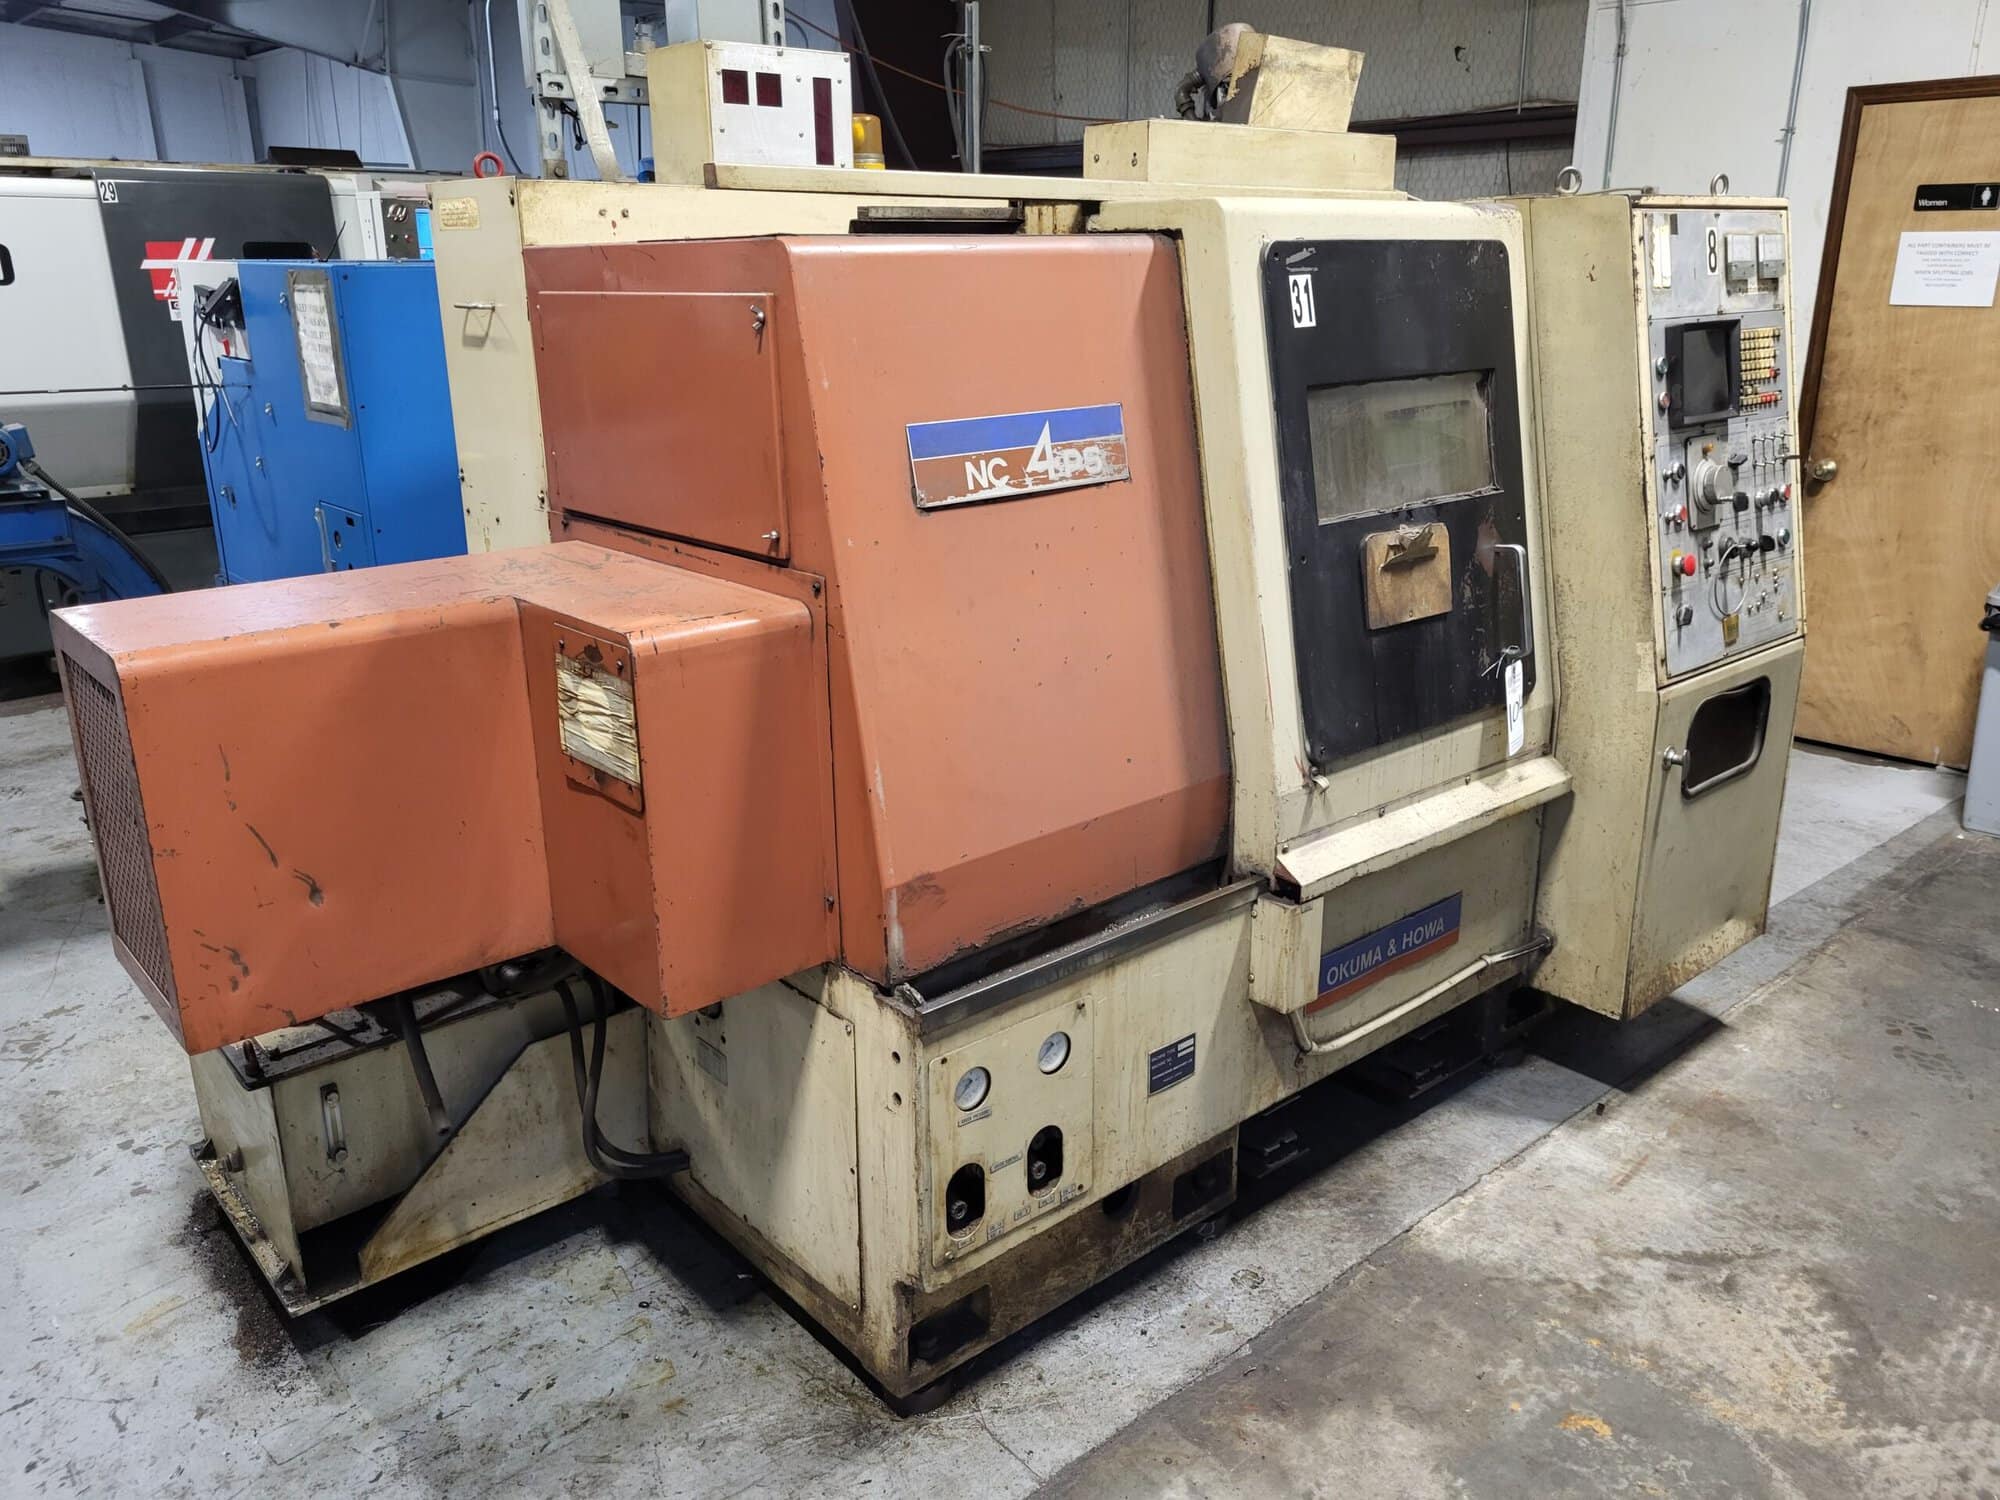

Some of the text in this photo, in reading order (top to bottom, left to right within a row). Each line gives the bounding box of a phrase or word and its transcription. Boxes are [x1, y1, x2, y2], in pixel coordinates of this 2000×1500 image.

[100, 181, 116, 201] 29
[1918, 199, 1948, 207] Women
[1708, 229, 1717, 273] 8
[1292, 278, 1313, 324] 31
[964, 457, 1011, 491] NC
[1326, 917, 1445, 985] OKUMA & HOWA
